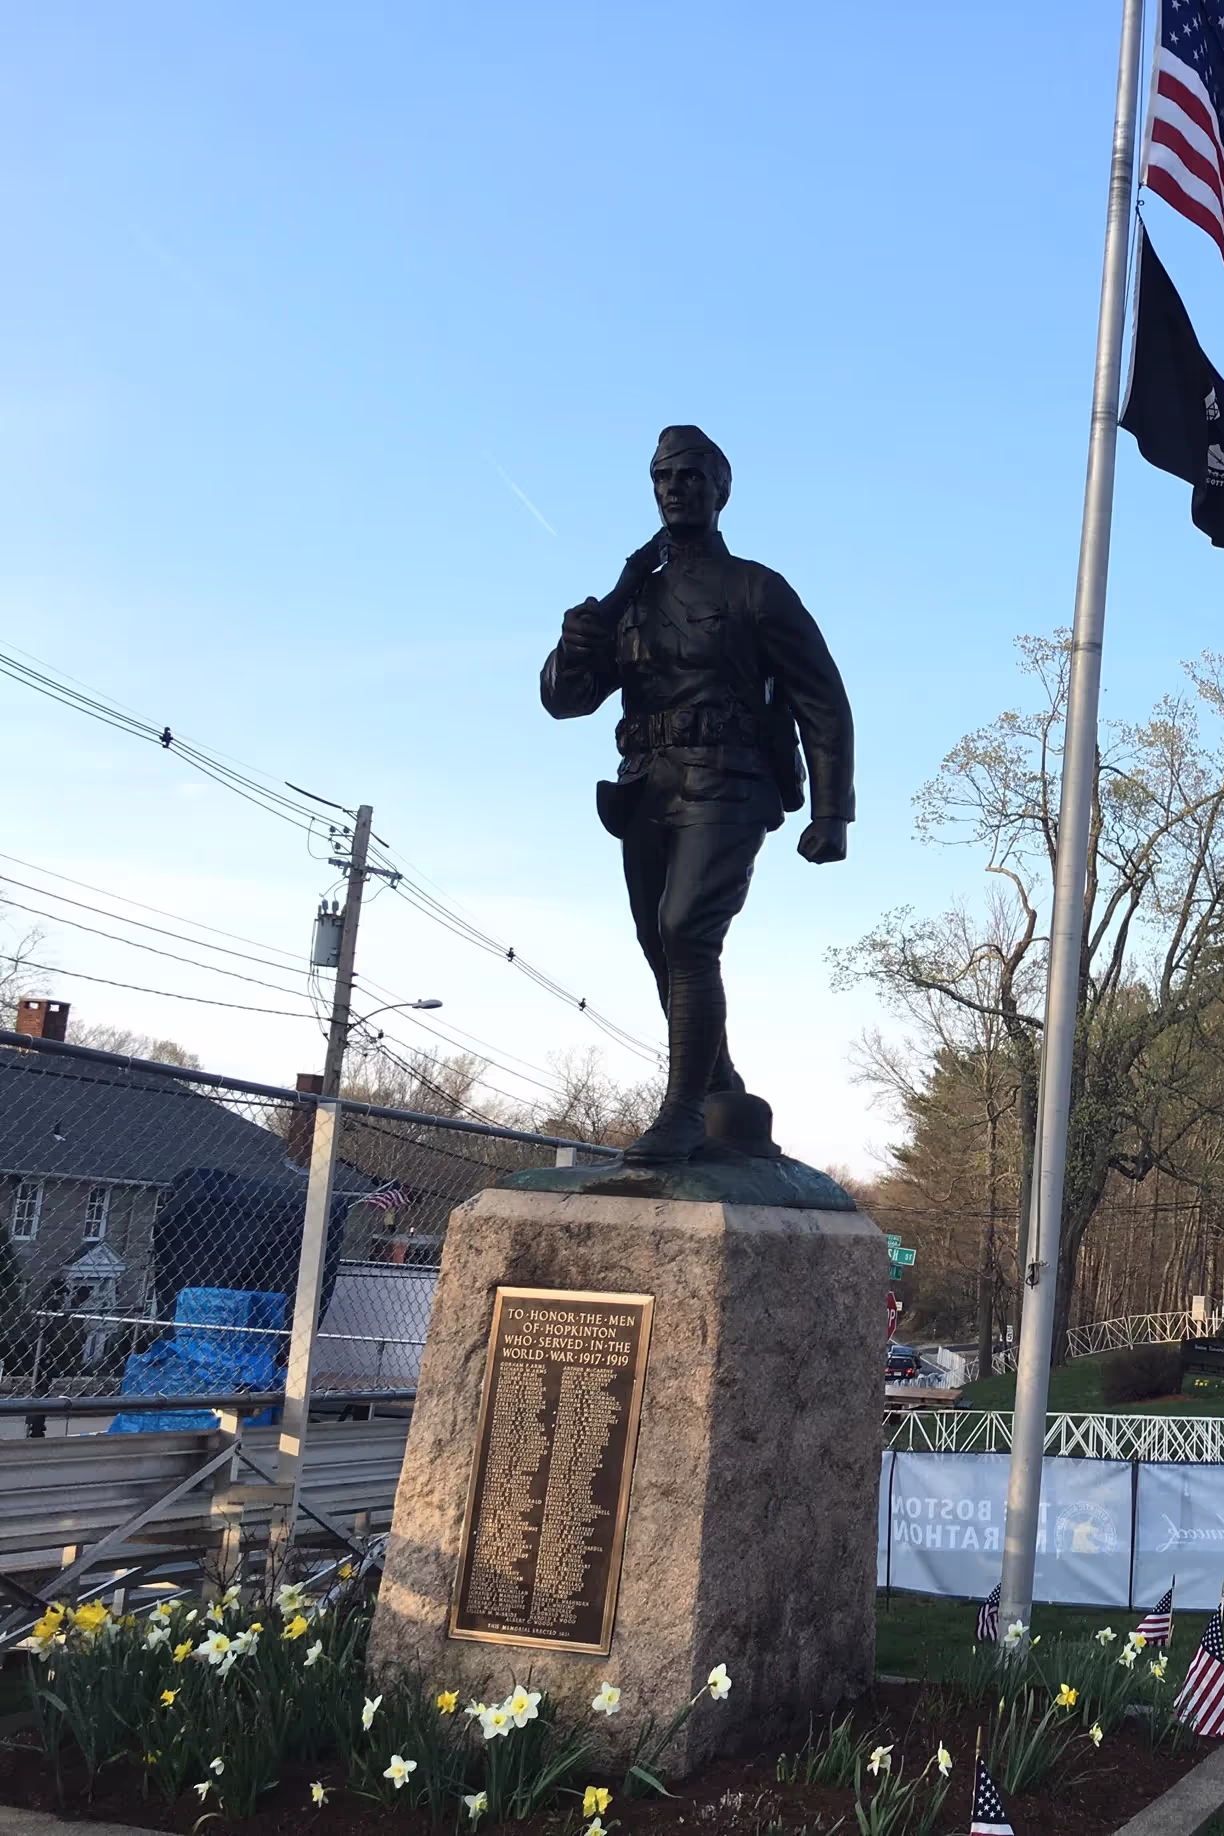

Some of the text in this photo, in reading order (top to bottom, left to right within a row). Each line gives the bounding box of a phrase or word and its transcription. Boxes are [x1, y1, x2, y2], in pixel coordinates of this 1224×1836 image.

[508, 1308, 636, 1327] TO HONOR THE MEN
[523, 1322, 617, 1338] OF HOPKINTON
[504, 1334, 631, 1354] WHO SERVED IN THE
[502, 1348, 629, 1366] WORLD WAR 1917 1919
